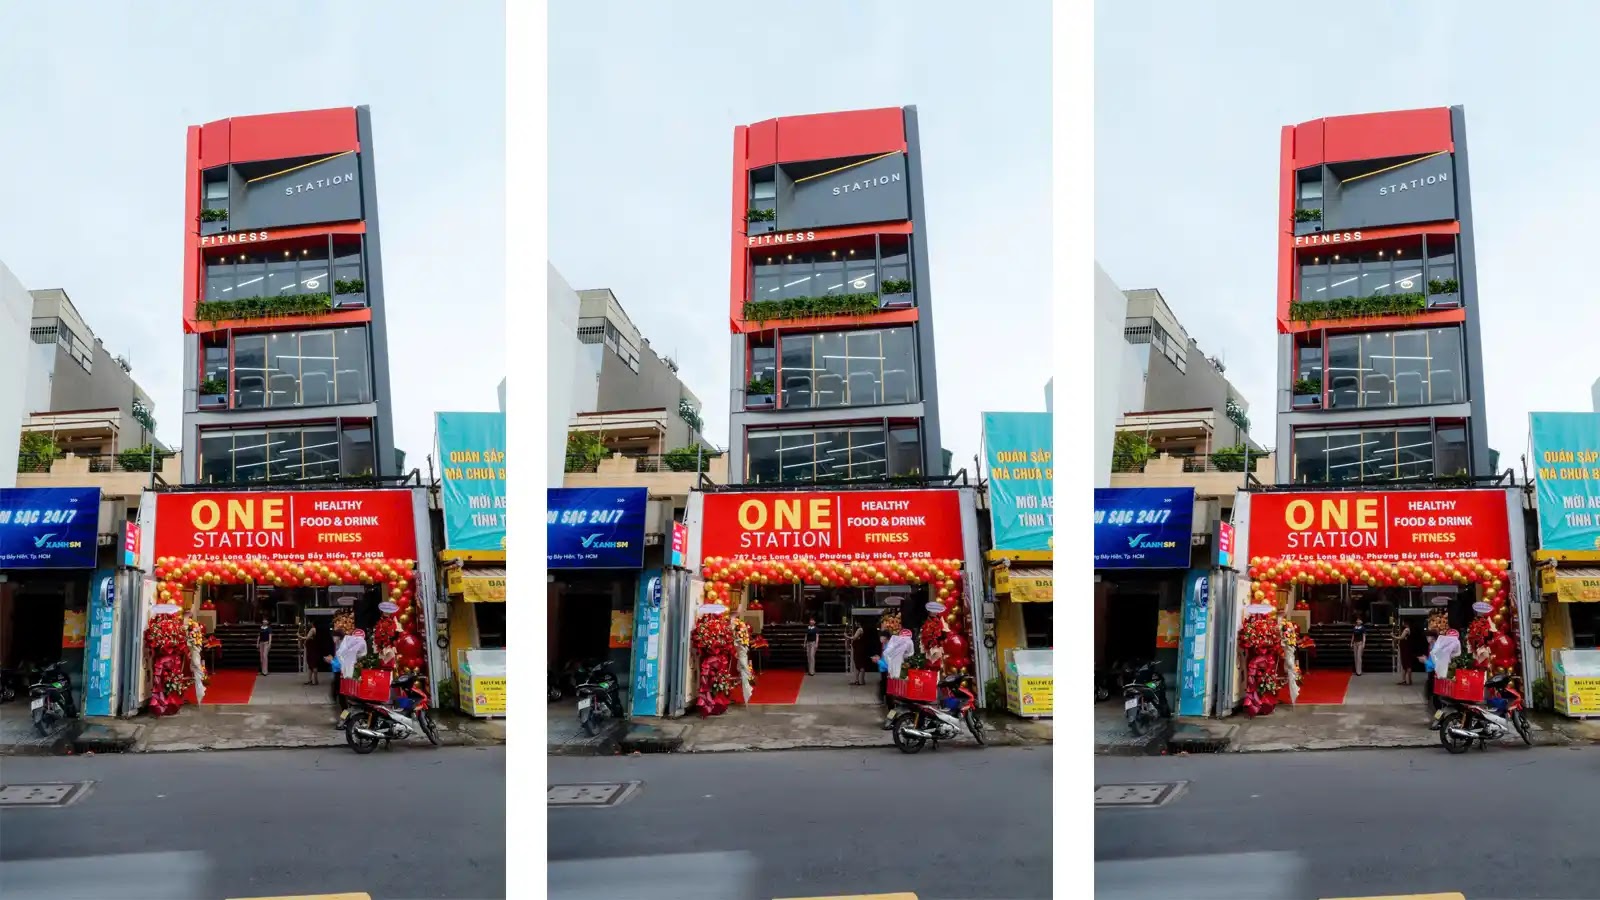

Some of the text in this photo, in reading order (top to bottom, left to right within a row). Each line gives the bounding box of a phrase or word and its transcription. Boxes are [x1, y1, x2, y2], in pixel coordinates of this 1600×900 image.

[285, 172, 354, 196] STATION
[832, 172, 900, 196] STATION
[1379, 172, 1448, 196] STATION
[202, 232, 268, 246] FITNESS
[748, 232, 815, 246] FITNESS
[1296, 232, 1362, 246] FITNESS
[314, 500, 362, 510] HEALTHY
[862, 500, 910, 510] HEALTHY
[1408, 500, 1456, 510] HEALTHY
[14, 510, 40, 526] SẠC
[42, 510, 77, 524] 24/7
[191, 499, 284, 530] ONE
[300, 516, 378, 526] FOOD & DRINK
[561, 510, 587, 526] SẠC
[589, 510, 624, 524] 24/7
[738, 499, 831, 530] ONE
[848, 516, 926, 526] FOOD & DRINK
[1108, 510, 1134, 526] SẠC
[1136, 510, 1171, 524] 24/7
[1285, 499, 1378, 530] ONE
[1394, 516, 1472, 526] FOOD & DRINK
[194, 532, 284, 548] STATION
[318, 533, 362, 542] FITNESS
[740, 532, 830, 548] STATION
[865, 533, 909, 542] FITNESS
[1288, 532, 1378, 548] STATION
[1412, 533, 1456, 542] FITNESS
